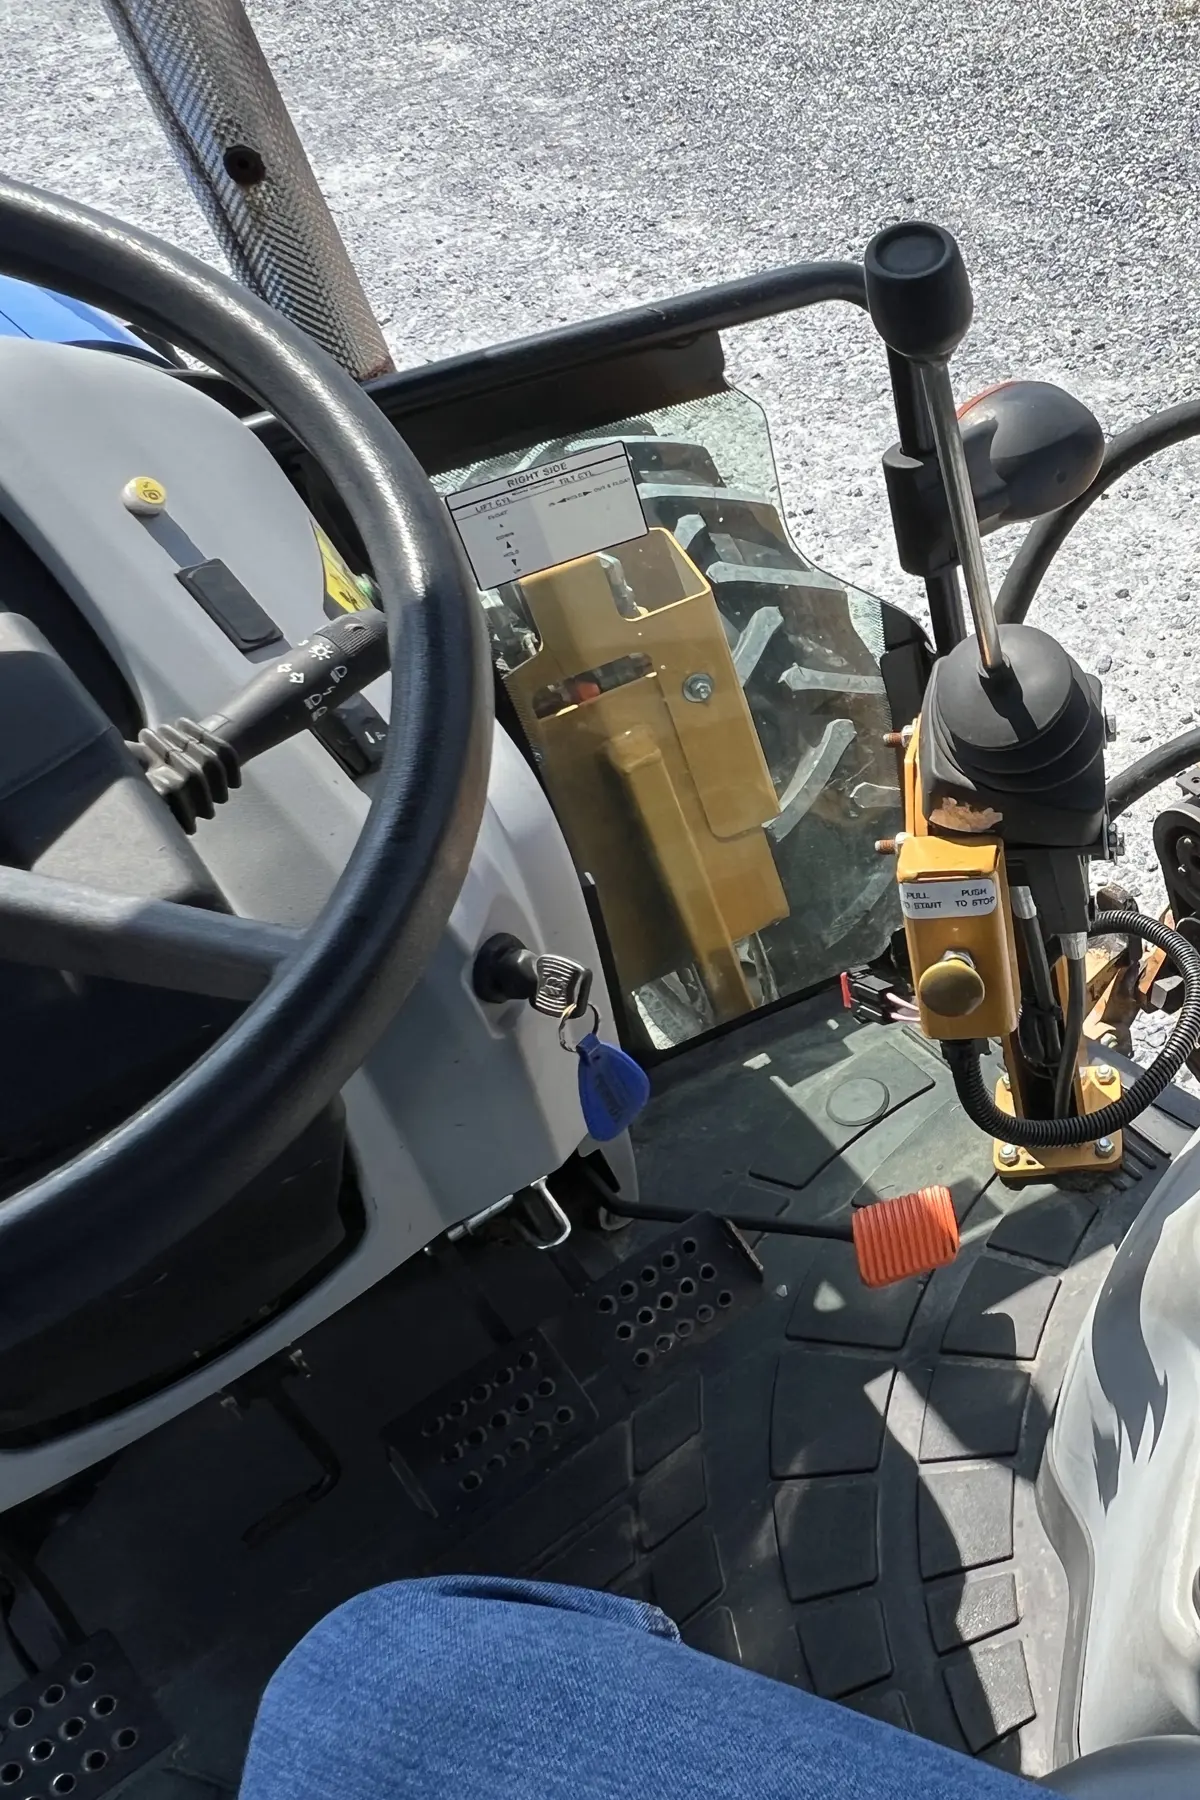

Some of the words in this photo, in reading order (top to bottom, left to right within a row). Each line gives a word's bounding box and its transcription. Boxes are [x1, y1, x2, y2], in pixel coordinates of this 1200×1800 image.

[507, 472, 540, 488] RIGHT
[543, 462, 568, 477] SIDE
[559, 475, 578, 485] TILT
[475, 501, 495, 513] LIFT
[495, 497, 513, 508] CYL
[488, 510, 508, 520] FLOAT
[914, 901, 943, 909] START
[955, 899, 968, 907] TO
[972, 896, 995, 906] STOP
